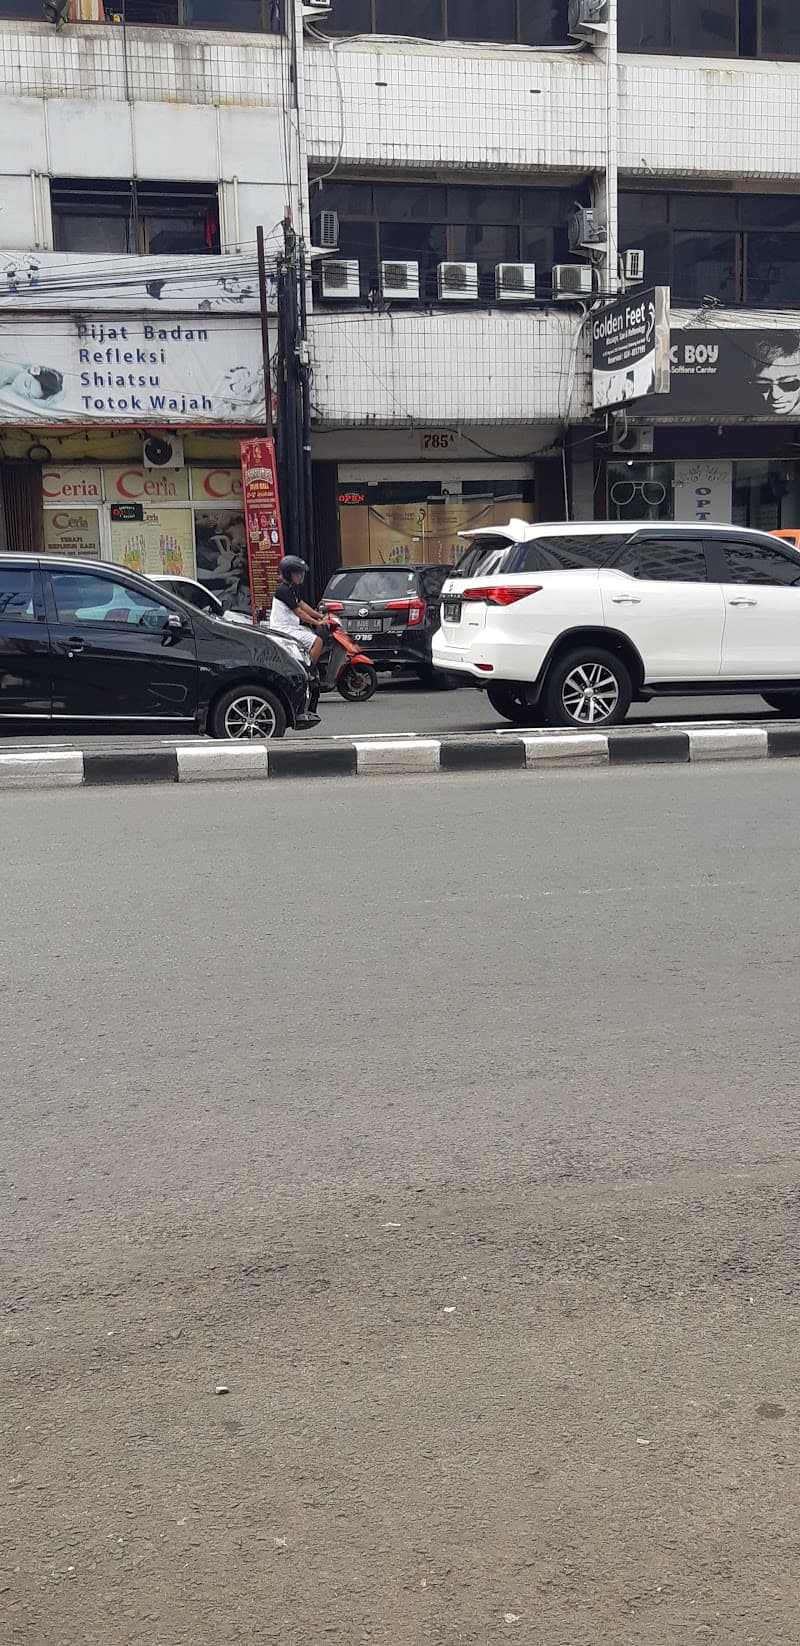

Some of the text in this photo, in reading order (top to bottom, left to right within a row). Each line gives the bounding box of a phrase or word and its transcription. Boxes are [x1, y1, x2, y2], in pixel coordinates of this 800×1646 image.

[593, 302, 646, 340] Golden Feet
[78, 324, 209, 344] Pijat Badan
[79, 348, 166, 364] Refleksi
[684, 344, 719, 364] BOY
[695, 365, 717, 374] Center
[80, 372, 160, 387] Shiatsu
[82, 395, 213, 413] Totok Wajah
[42, 472, 99, 497] Ceria
[116, 470, 176, 498] Ceria
[338, 494, 365, 504] OPEN
[52, 512, 88, 529] Ceria
